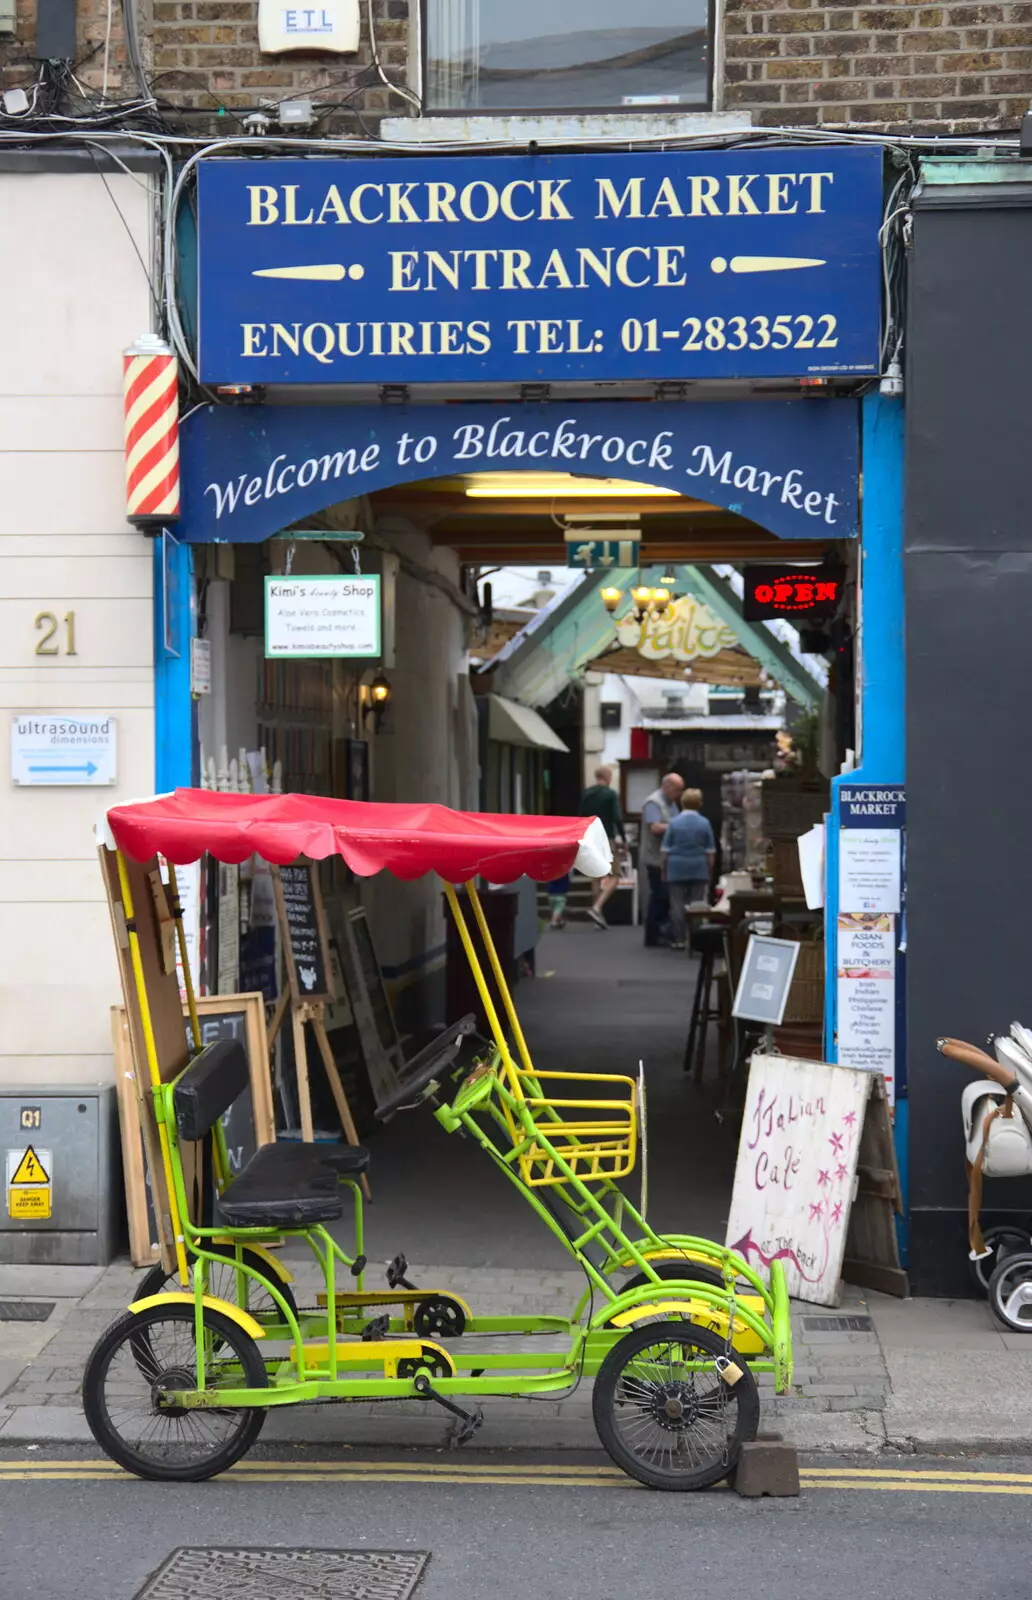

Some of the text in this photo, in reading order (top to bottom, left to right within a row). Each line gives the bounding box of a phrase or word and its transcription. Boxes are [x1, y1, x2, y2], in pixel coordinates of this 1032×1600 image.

[286, 10, 333, 27] ETL
[246, 172, 834, 226] BLACKROCK MARKET
[387, 245, 688, 292] ENTRANCE
[240, 314, 838, 365] ENQUIRIES TEL: 01-2833522
[204, 416, 839, 524] Welcome to Blackrock Market
[342, 585, 374, 599] Shop
[754, 581, 838, 604] OPEN
[35, 611, 78, 656] 21
[286, 623, 315, 633] Towels
[317, 623, 332, 632] and
[18, 720, 110, 735] ultrasound
[50, 734, 110, 745] dimensions
[840, 790, 906, 802] BLACKROCK
[849, 803, 898, 815] MARKET
[853, 933, 883, 941] ASIAN
[851, 941, 886, 949] FOODS
[842, 958, 892, 966] BUTCHERY
[21, 1110, 41, 1128] Q1
